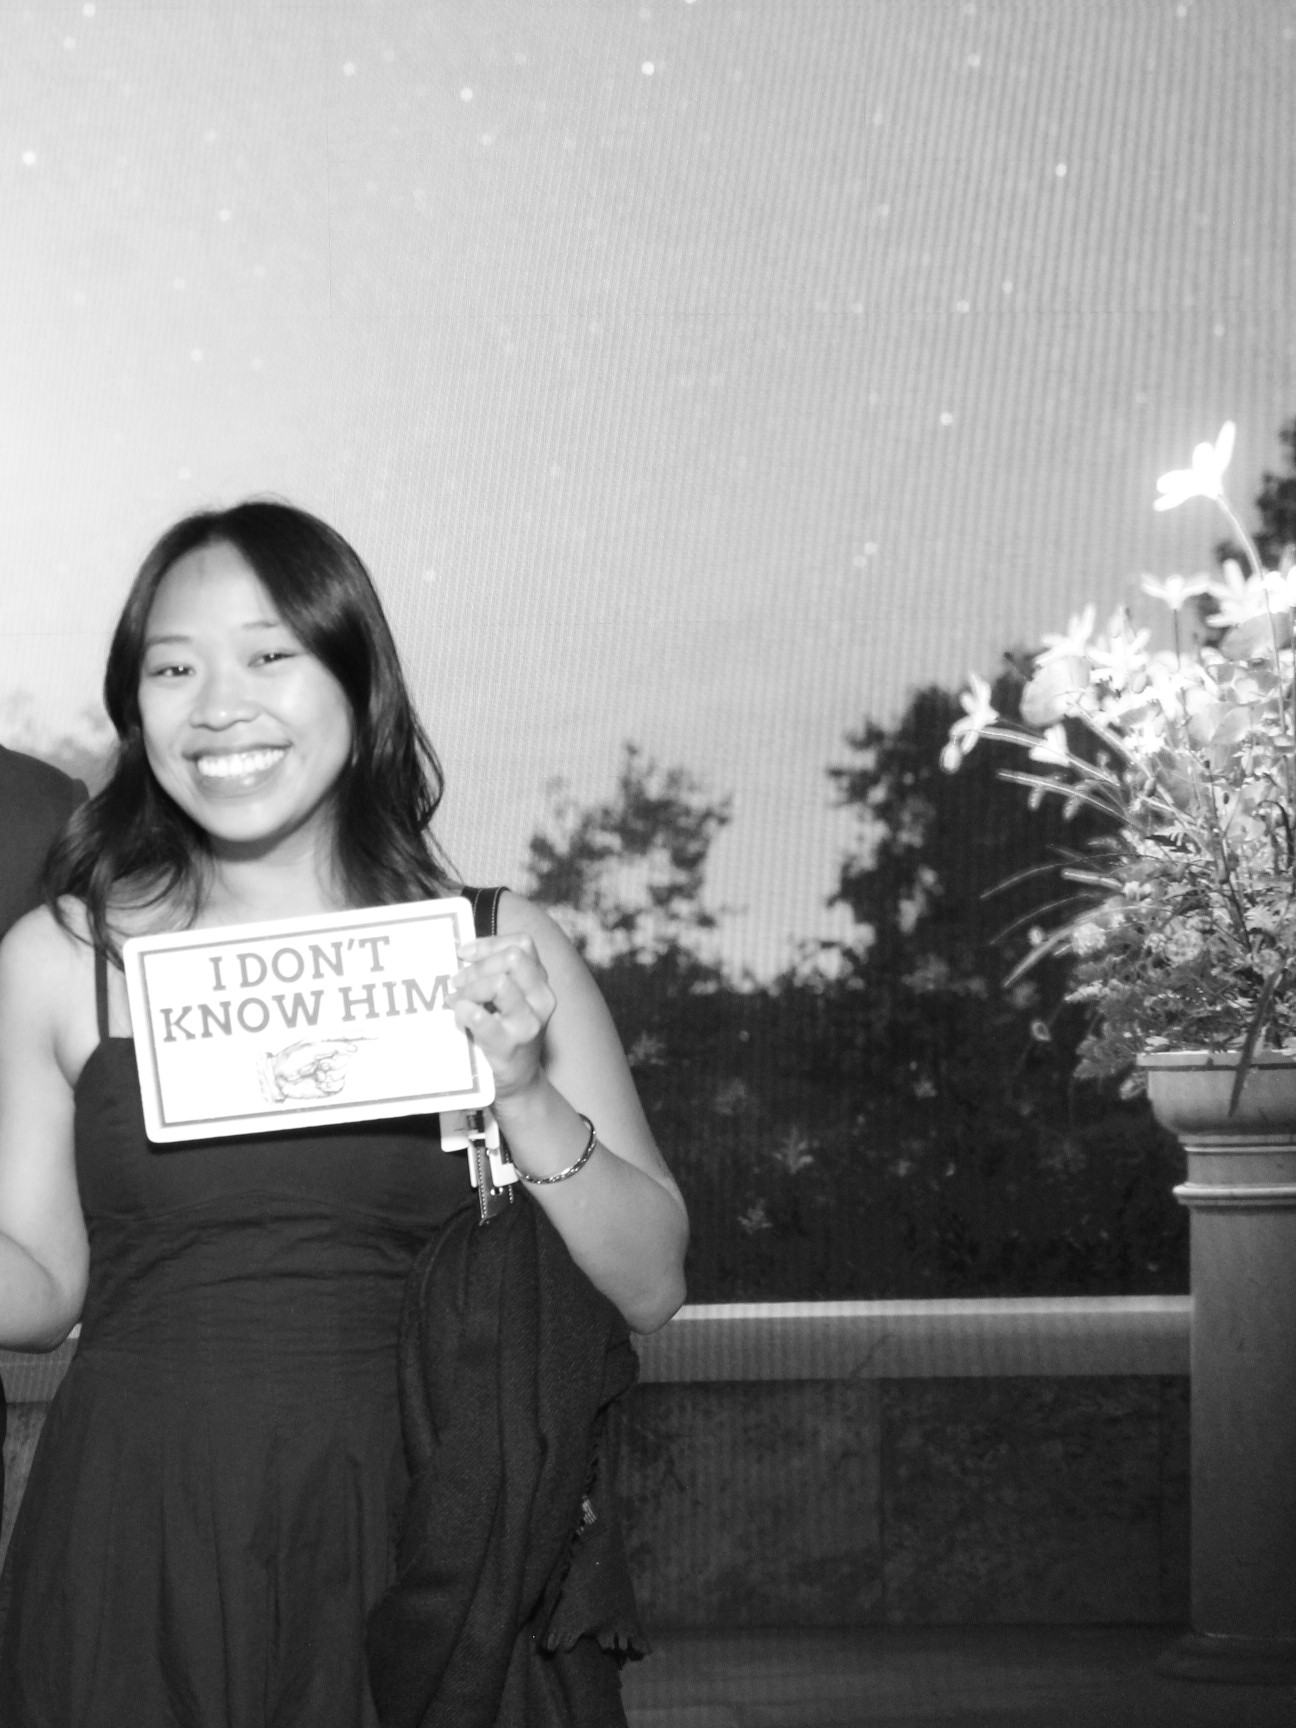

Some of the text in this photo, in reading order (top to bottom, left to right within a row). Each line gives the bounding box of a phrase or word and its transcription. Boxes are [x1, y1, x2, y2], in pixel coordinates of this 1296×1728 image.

[209, 956, 227, 991] I
[160, 974, 452, 1043] KNOW HIM
